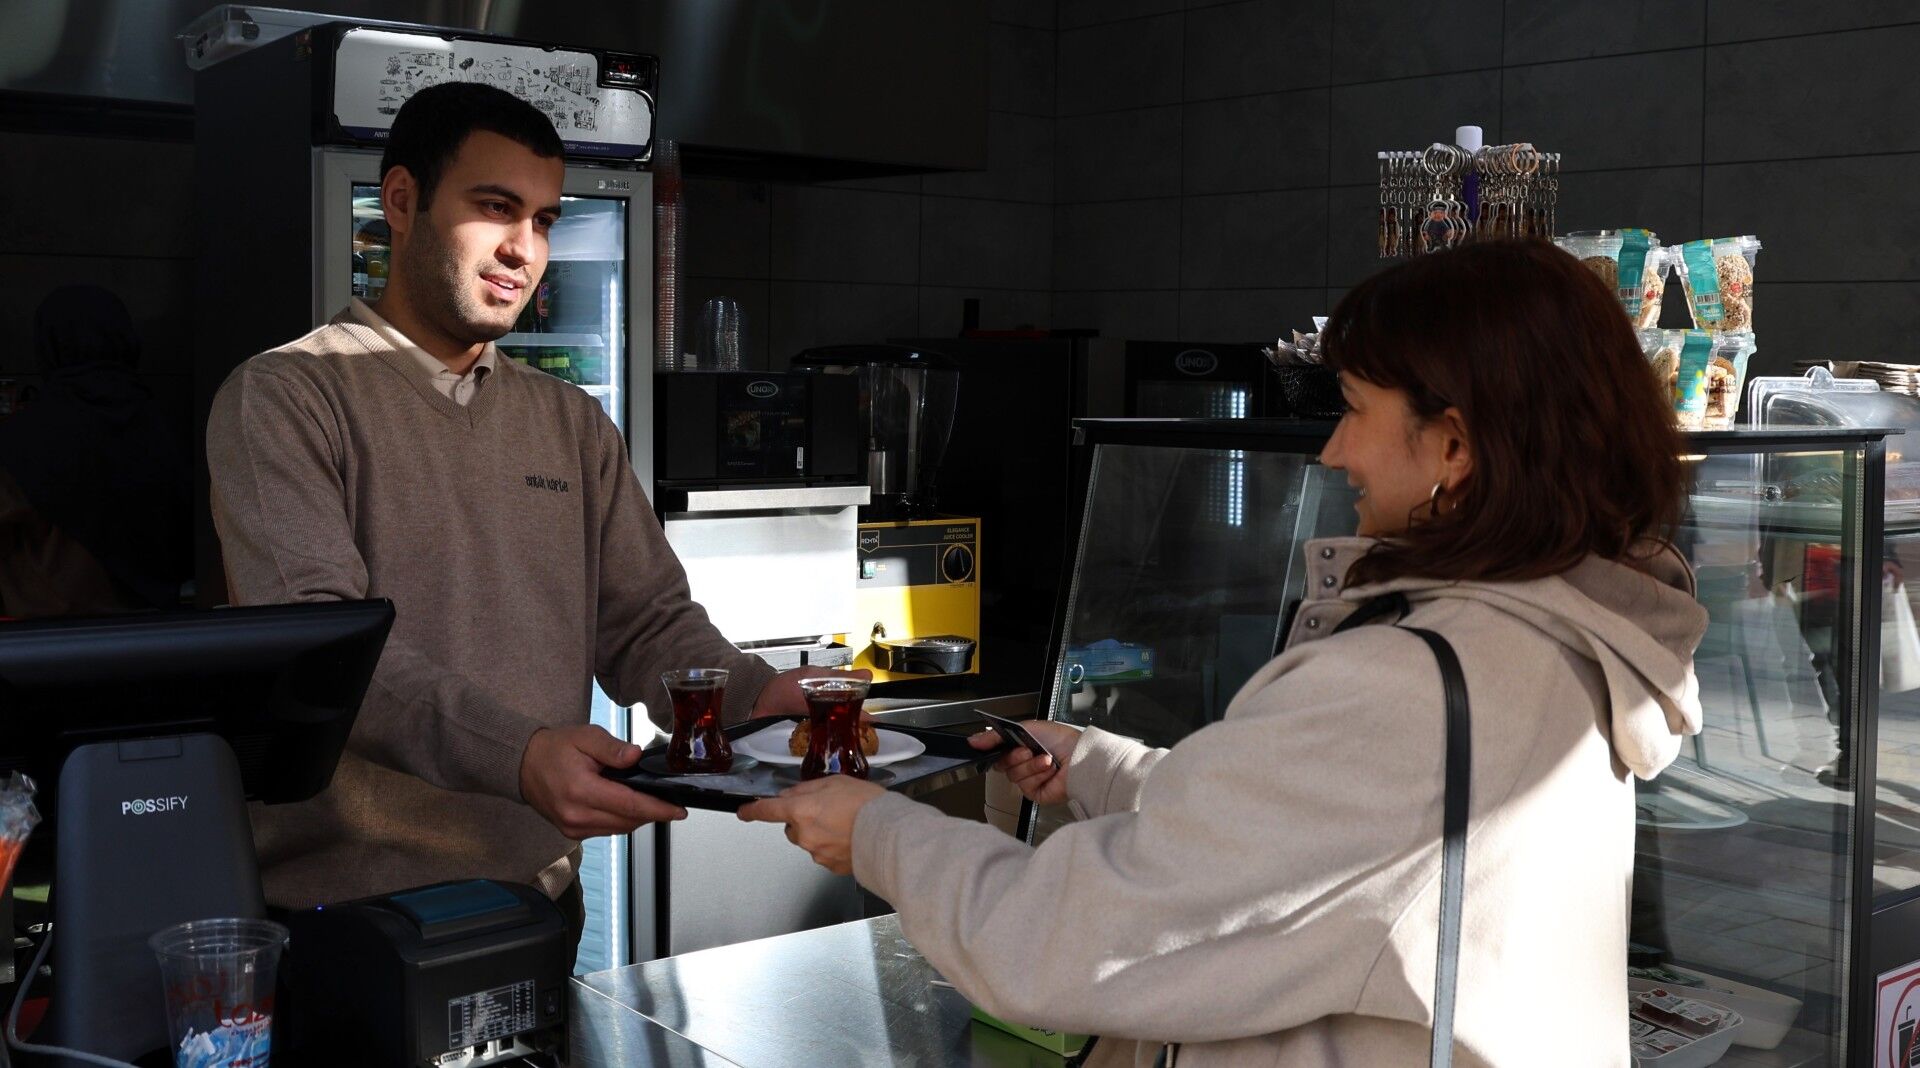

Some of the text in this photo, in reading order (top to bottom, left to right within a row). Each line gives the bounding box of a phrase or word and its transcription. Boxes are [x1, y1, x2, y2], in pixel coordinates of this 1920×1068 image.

[1180, 356, 1214, 368] UNOX
[750, 385, 776, 394] UNOX
[121, 795, 188, 816] POSSIFY
